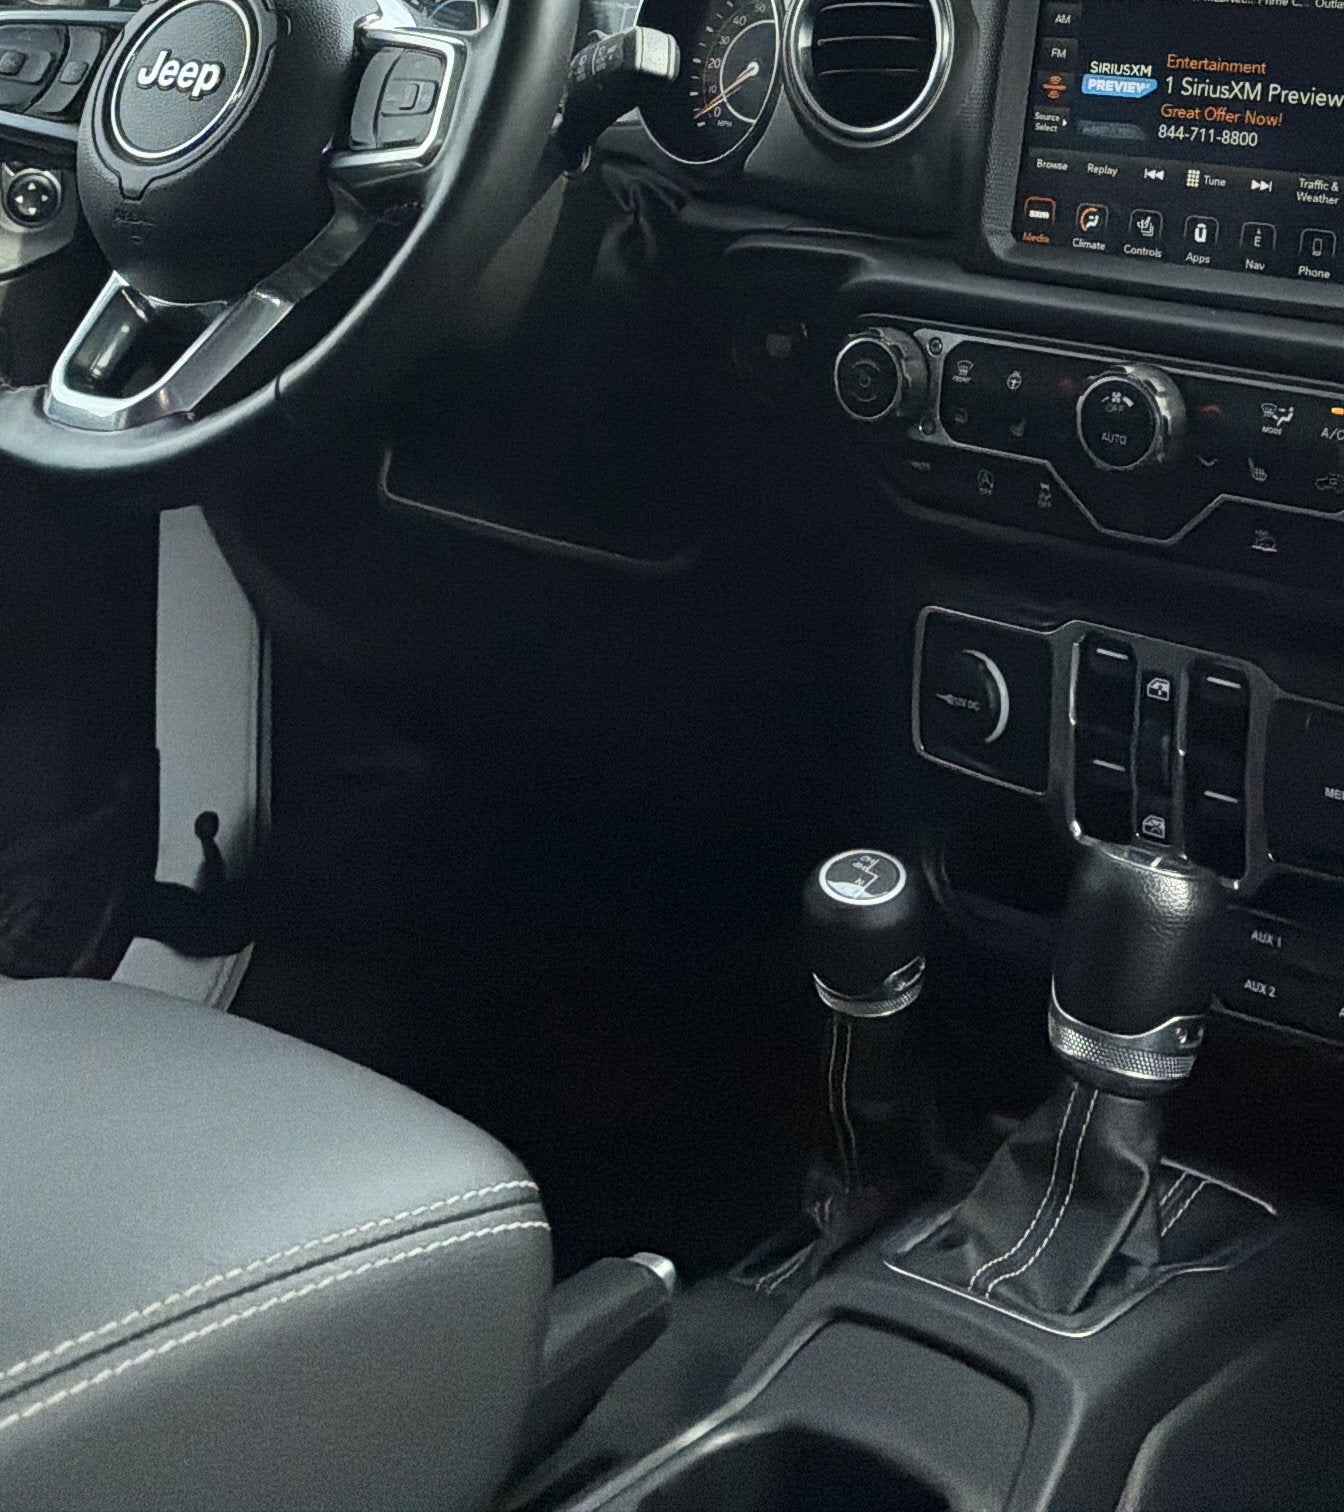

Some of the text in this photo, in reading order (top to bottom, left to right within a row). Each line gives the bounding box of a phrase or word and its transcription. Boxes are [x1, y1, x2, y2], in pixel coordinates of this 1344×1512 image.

[733, 15, 747, 26] 40
[1054, 14, 1071, 24] AM
[1051, 48, 1067, 59] FM
[707, 58, 721, 69] 20
[1090, 61, 1152, 77] SIRIUSXM
[1167, 53, 1268, 75] Entertainment
[137, 50, 222, 98] Jeep
[1088, 79, 1151, 94] PREVIEW
[1165, 76, 1344, 108] 1 SiriusXM Preview
[1160, 103, 1283, 127] Great Offer Now!
[1158, 124, 1258, 147] 844-711-8800
[1036, 158, 1069, 171] Browse
[1087, 163, 1119, 178] Replay
[1204, 175, 1227, 187] Tune
[1299, 177, 1329, 192] Traffic
[1296, 191, 1339, 205] Weather
[1072, 237, 1106, 251] Climate
[1123, 244, 1163, 258] Controls
[1185, 251, 1211, 265] Apps
[1245, 258, 1266, 271] Nav
[1298, 265, 1331, 279] Phone
[1101, 432, 1127, 445] AUTO
[1251, 930, 1282, 948] AUX 1
[1244, 979, 1277, 998] AUX 2
